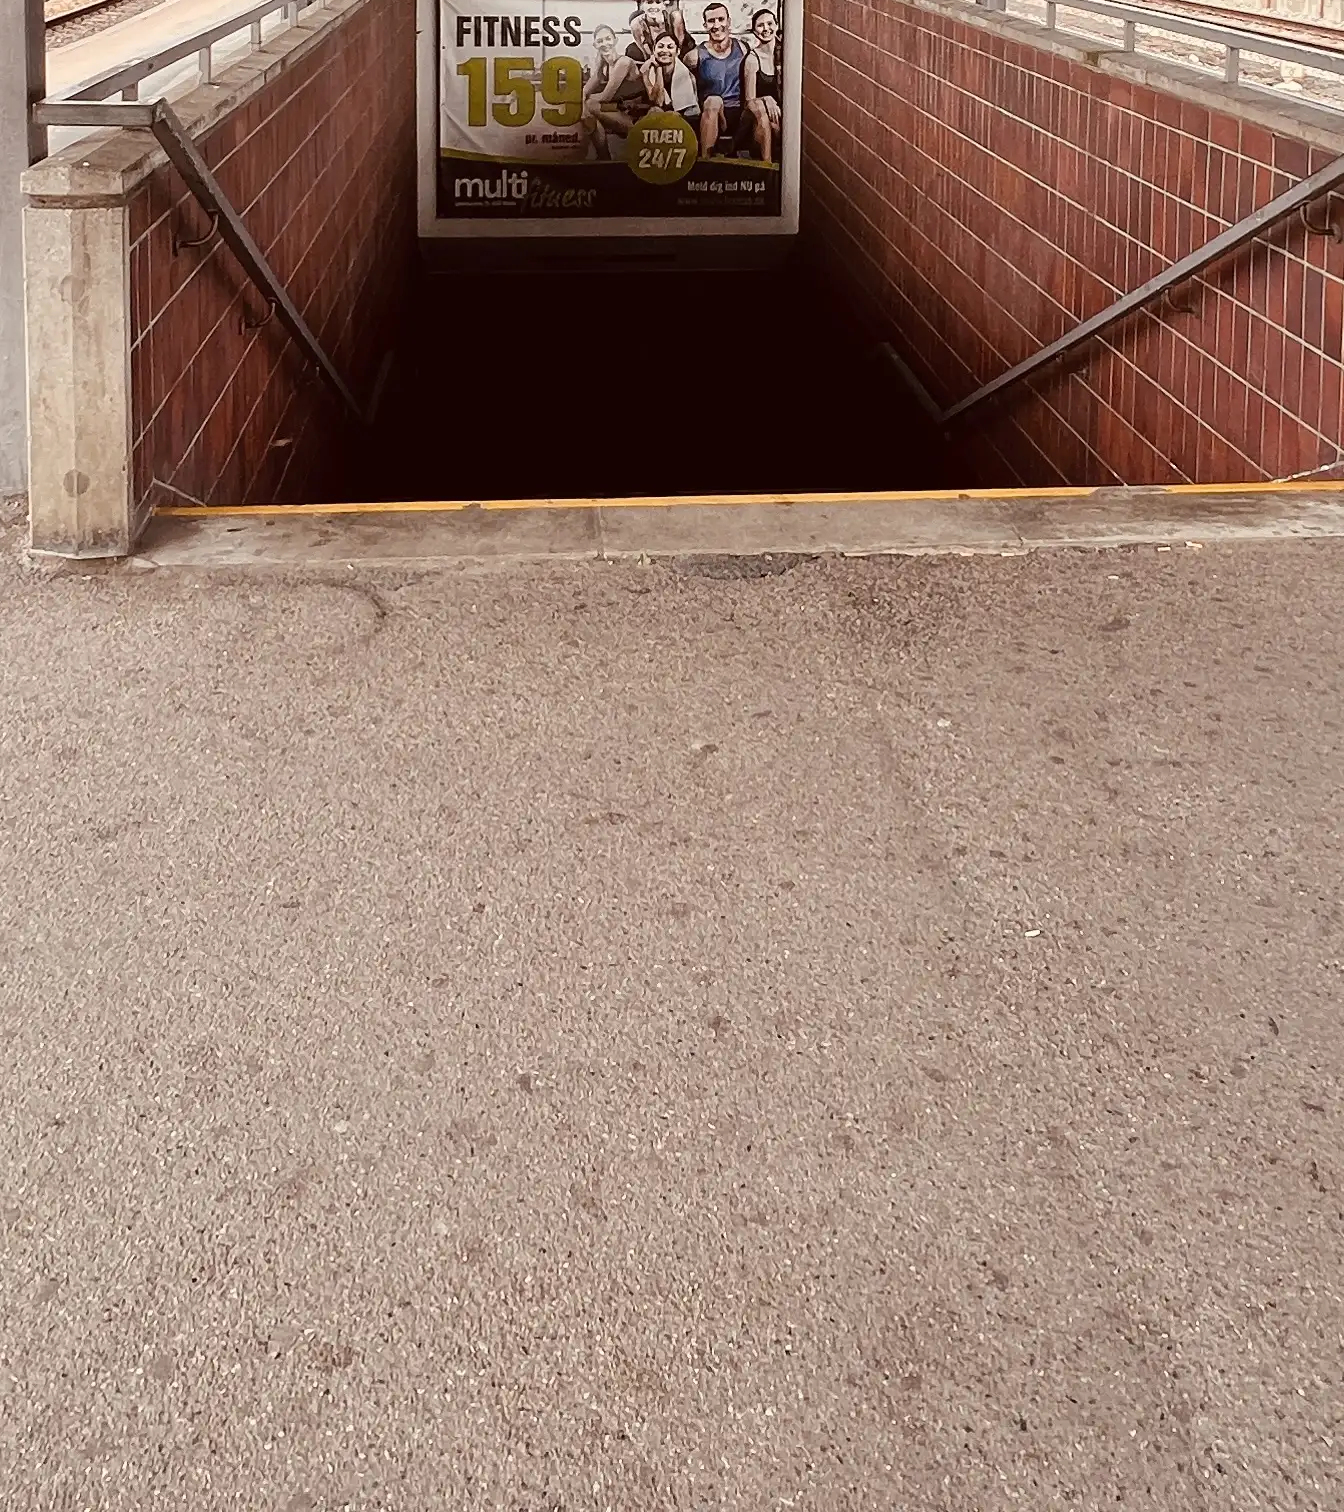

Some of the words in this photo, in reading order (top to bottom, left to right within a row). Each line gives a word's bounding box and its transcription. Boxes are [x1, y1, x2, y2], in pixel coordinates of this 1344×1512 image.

[456, 15, 582, 48] FITNESS
[456, 56, 584, 128] 159
[642, 128, 684, 144] TRÆN
[638, 147, 687, 170] 24/7
[454, 169, 529, 199] multi
